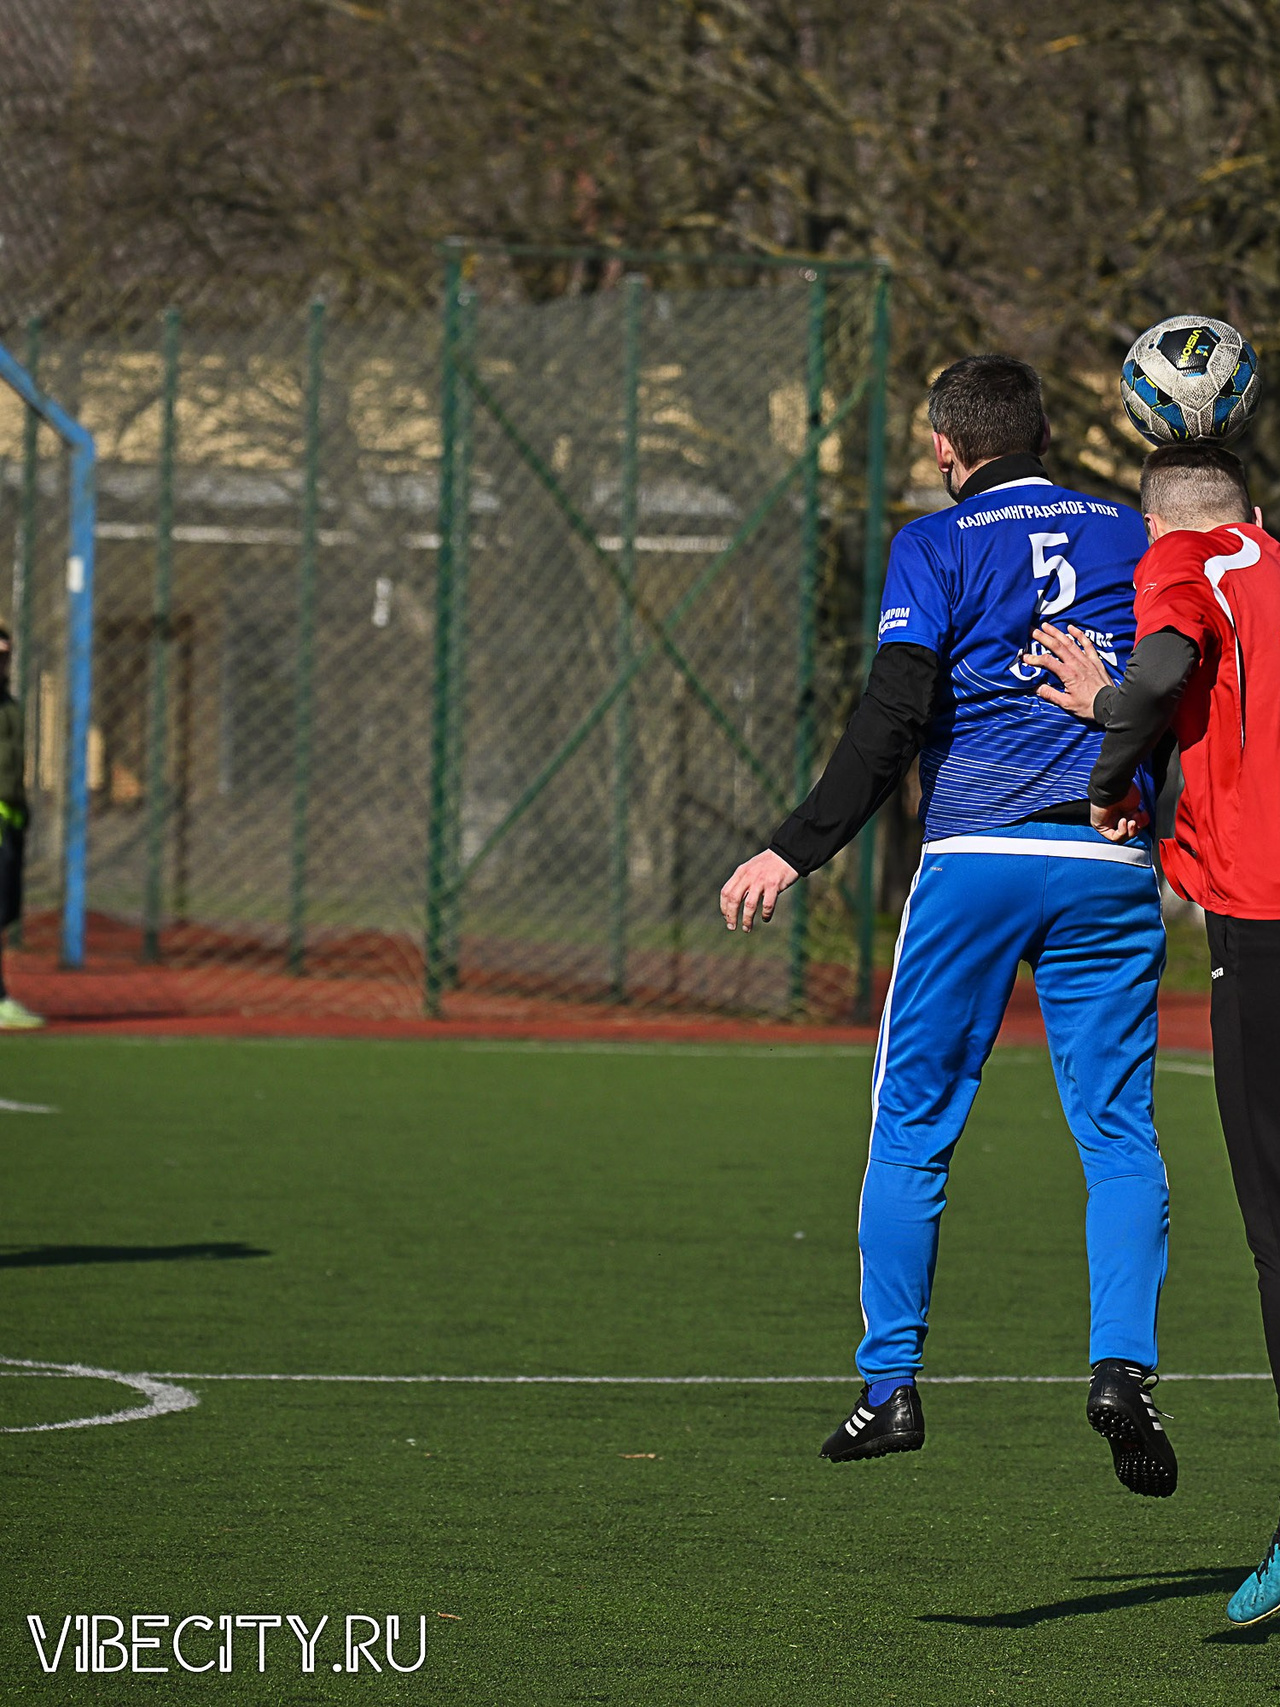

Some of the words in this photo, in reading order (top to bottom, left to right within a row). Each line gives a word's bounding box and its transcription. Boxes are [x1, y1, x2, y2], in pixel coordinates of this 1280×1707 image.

[956, 501, 1087, 530] КАЛИНИНГРАДСКОЕ
[1086, 501, 1119, 518] УПХГ
[1028, 532, 1077, 615] 5
